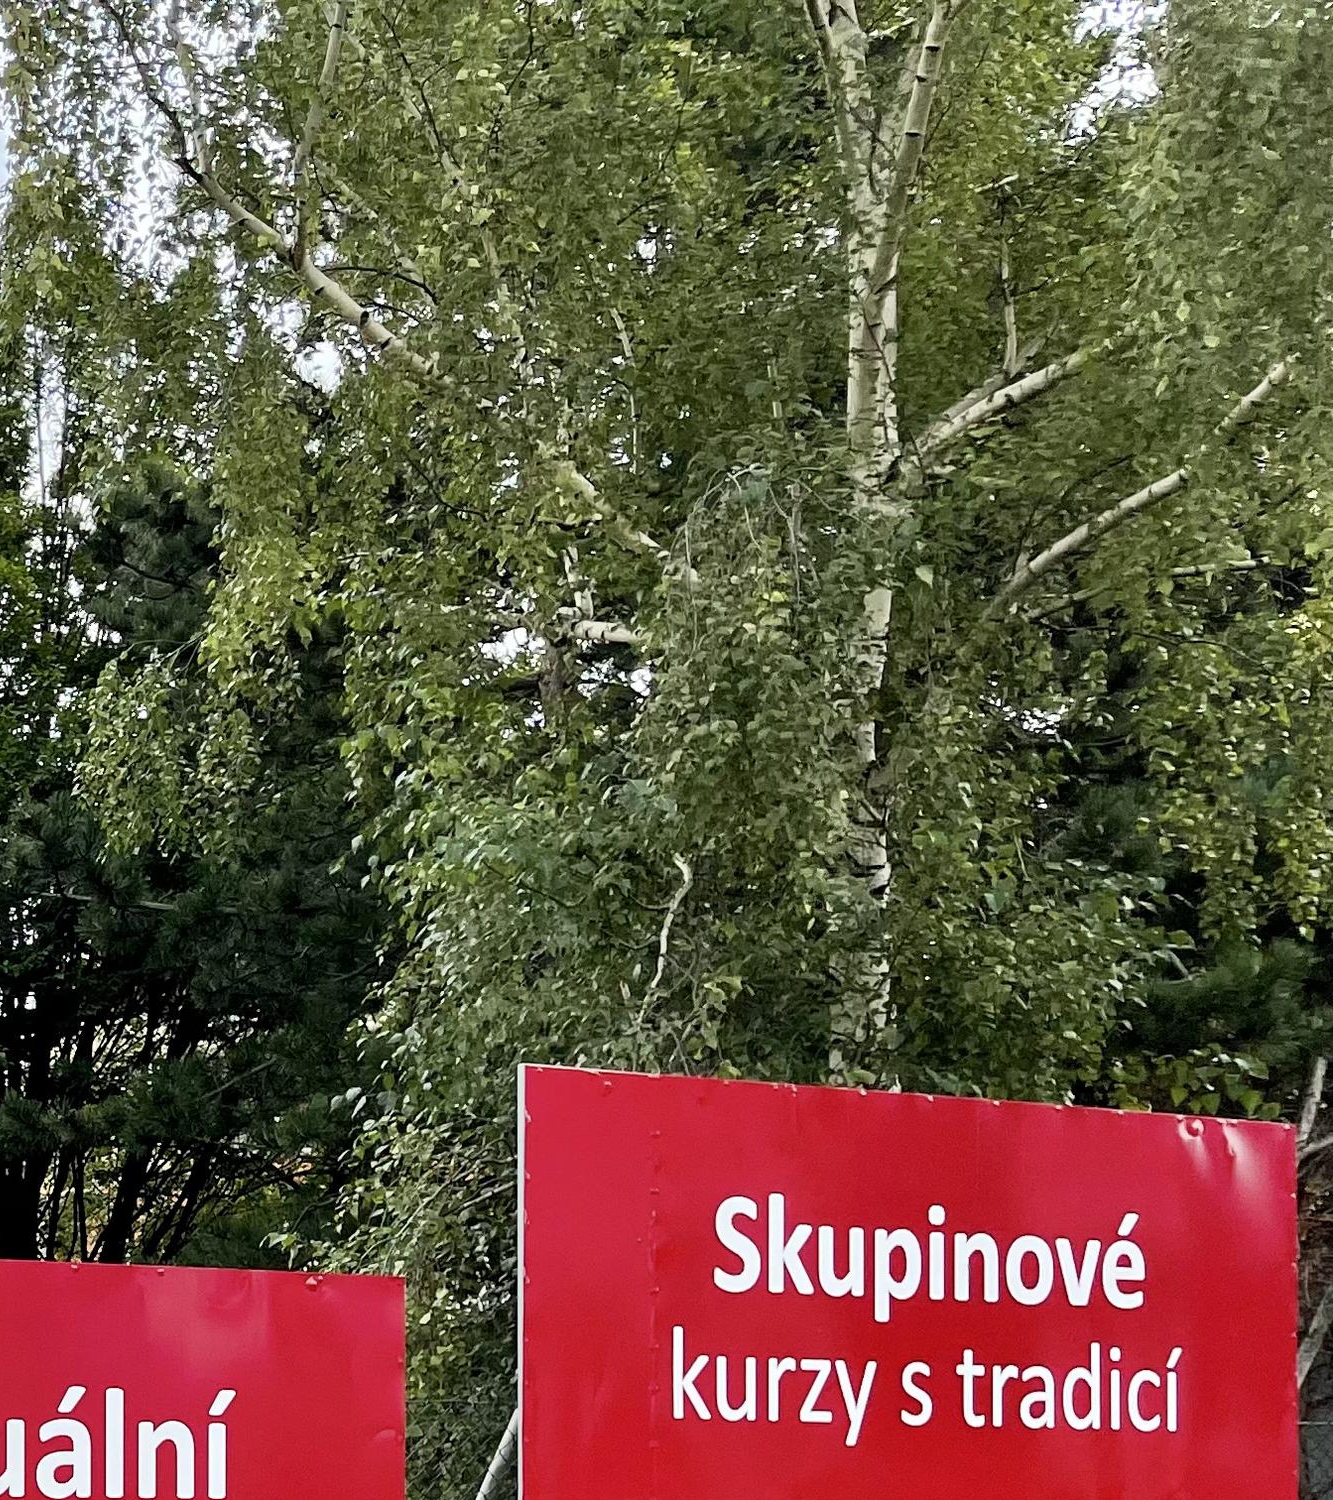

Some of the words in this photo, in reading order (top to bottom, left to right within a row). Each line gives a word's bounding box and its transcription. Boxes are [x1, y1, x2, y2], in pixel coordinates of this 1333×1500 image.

[713, 1192, 1146, 1322] Skupinové
[673, 1326, 878, 1446] kurzy
[900, 1361, 933, 1427] s
[955, 1342, 1183, 1433] tradicí
